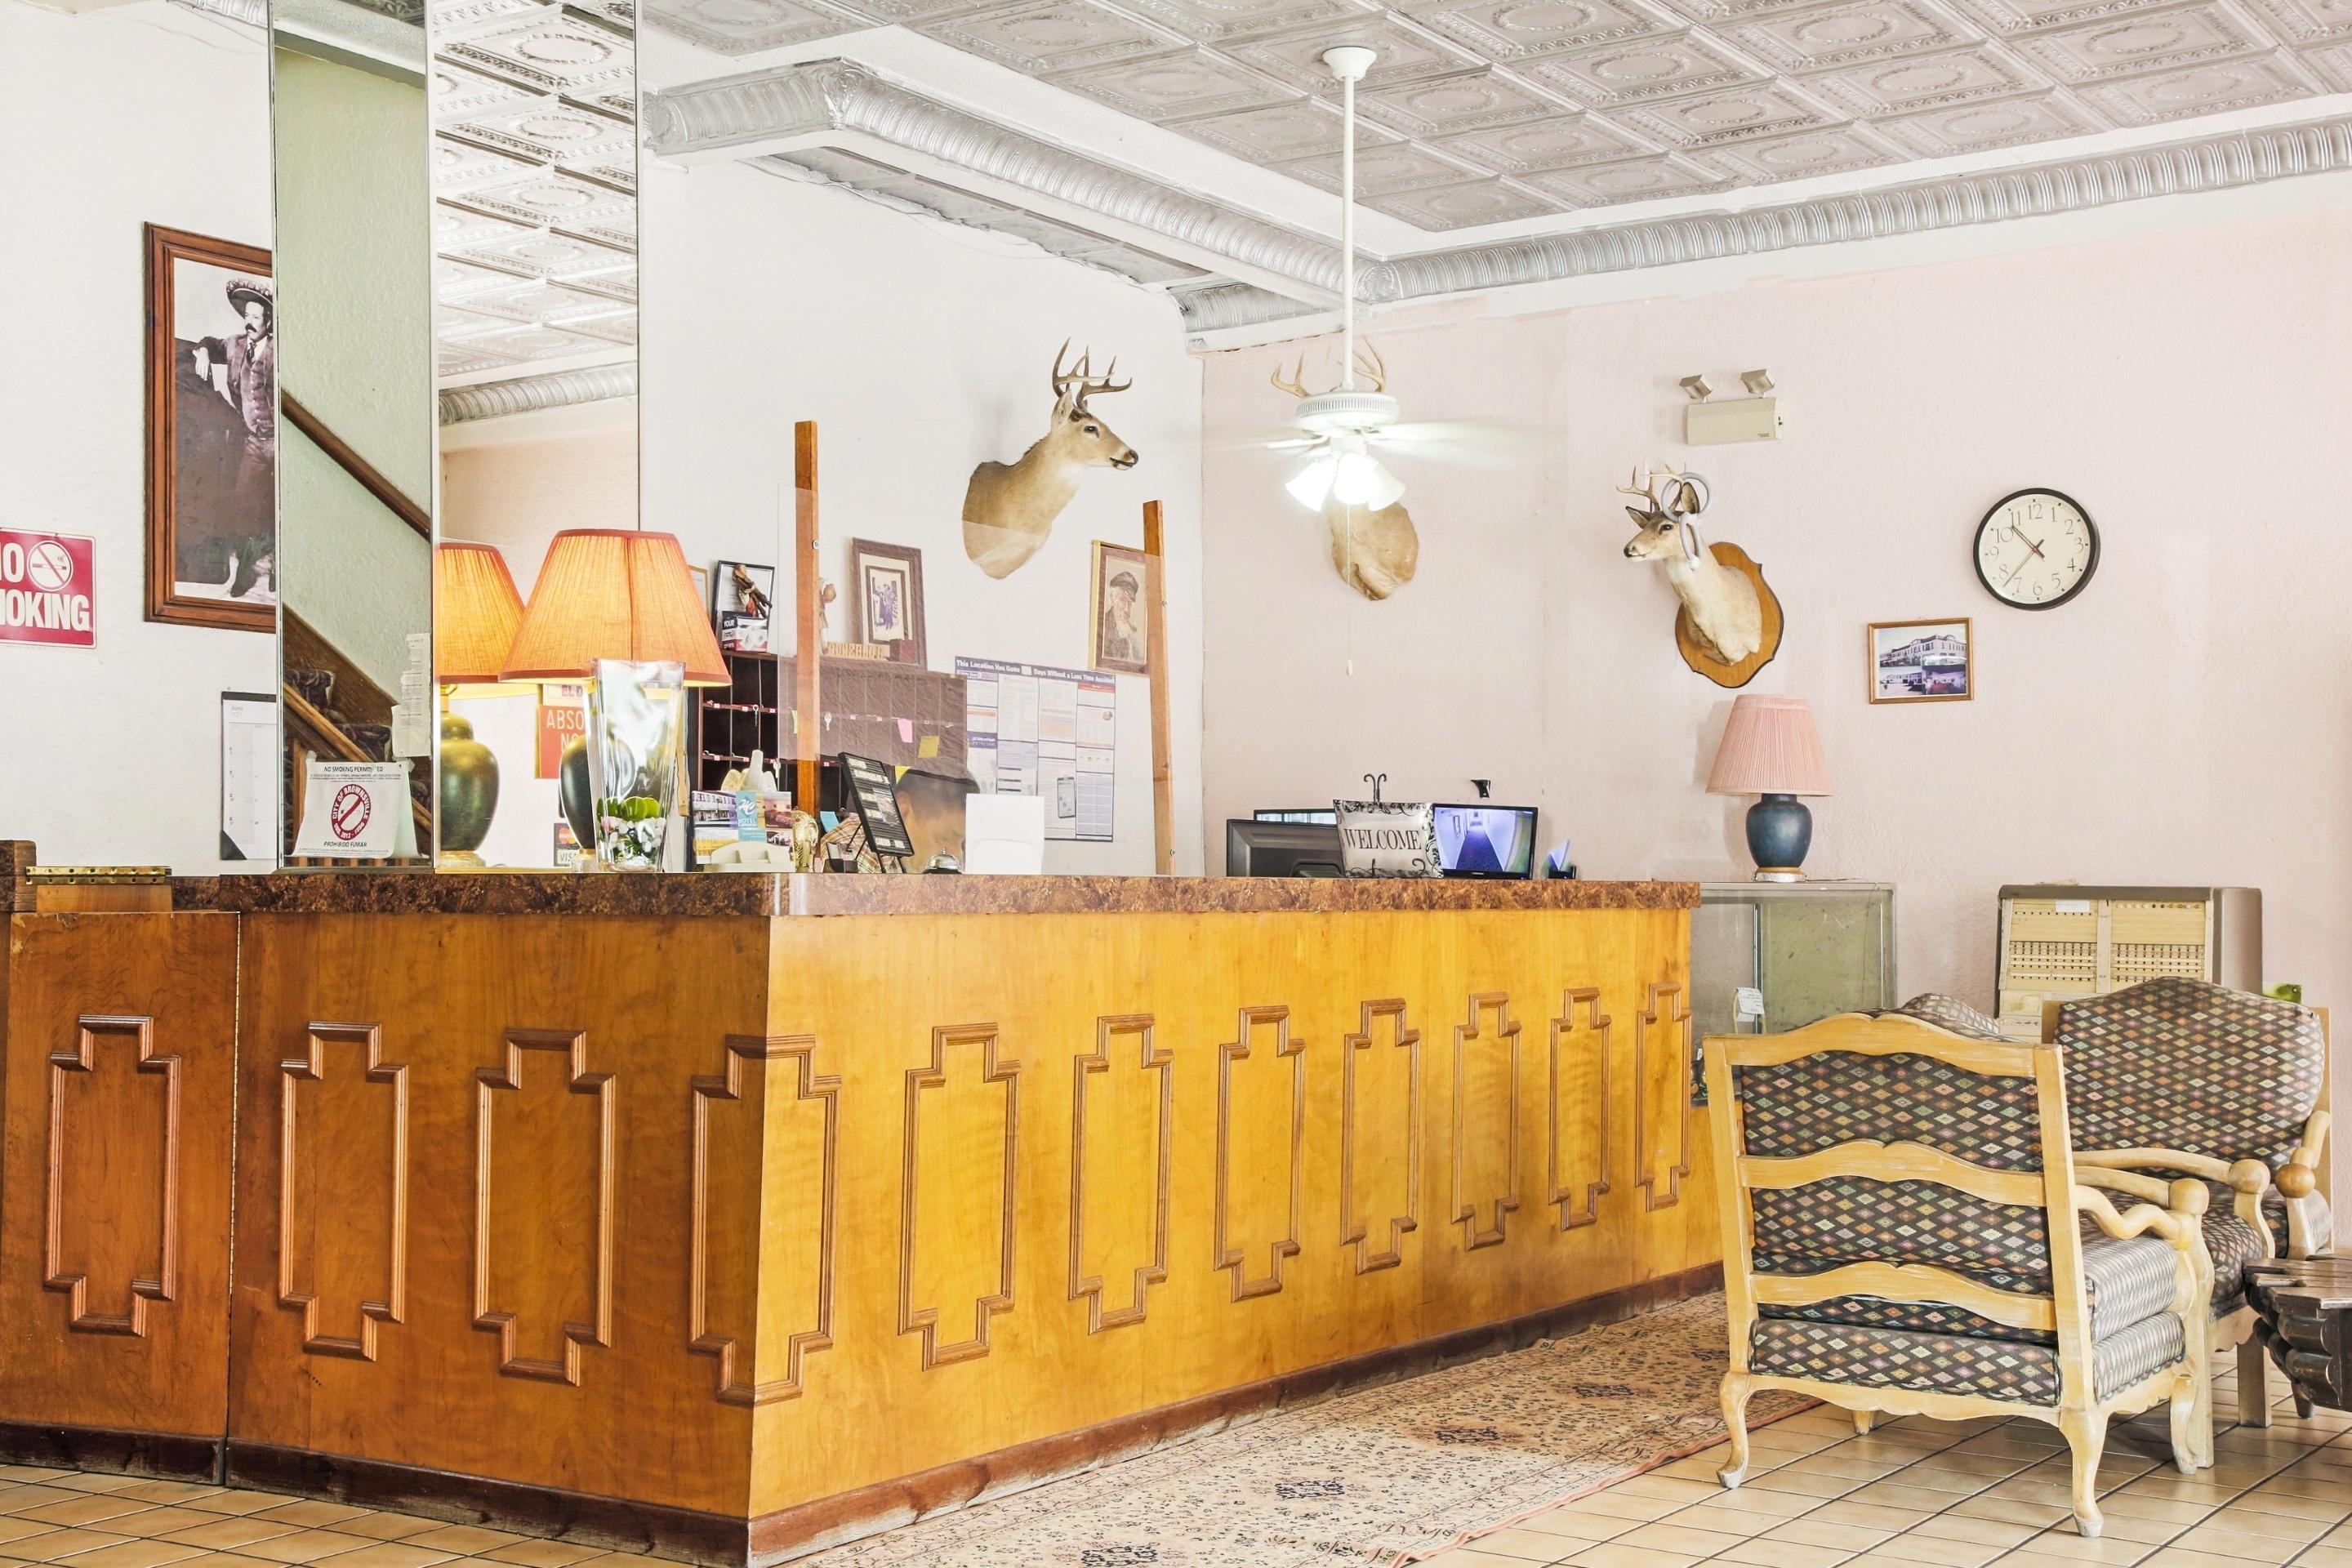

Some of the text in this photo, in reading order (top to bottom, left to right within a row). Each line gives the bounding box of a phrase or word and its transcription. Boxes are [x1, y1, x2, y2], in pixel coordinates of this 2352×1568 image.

[2011, 511, 2021, 526] 11
[2029, 503, 2042, 520] 12
[2051, 506, 2057, 522] 1
[1996, 527, 2013, 543] 10
[2065, 519, 2074, 535] 2
[1989, 546, 1999, 561] 9
[2074, 537, 2083, 554] 3
[0, 541, 24, 583] O
[2067, 557, 2076, 572] 4
[1998, 564, 2009, 580] 8
[2014, 577, 2022, 593] 7
[2033, 581, 2042, 596] 6
[2051, 572, 2061, 589] 5
[0, 588, 90, 631] OKING
[970, 662, 995, 670] Location
[1034, 668, 1046, 676] Days
[1047, 670, 1066, 679] Without
[1095, 675, 1115, 684] Accident
[336, 791, 345, 802] OF
[343, 785, 371, 820] BROWNSVILLE
[1343, 828, 1422, 850] WELCOME
